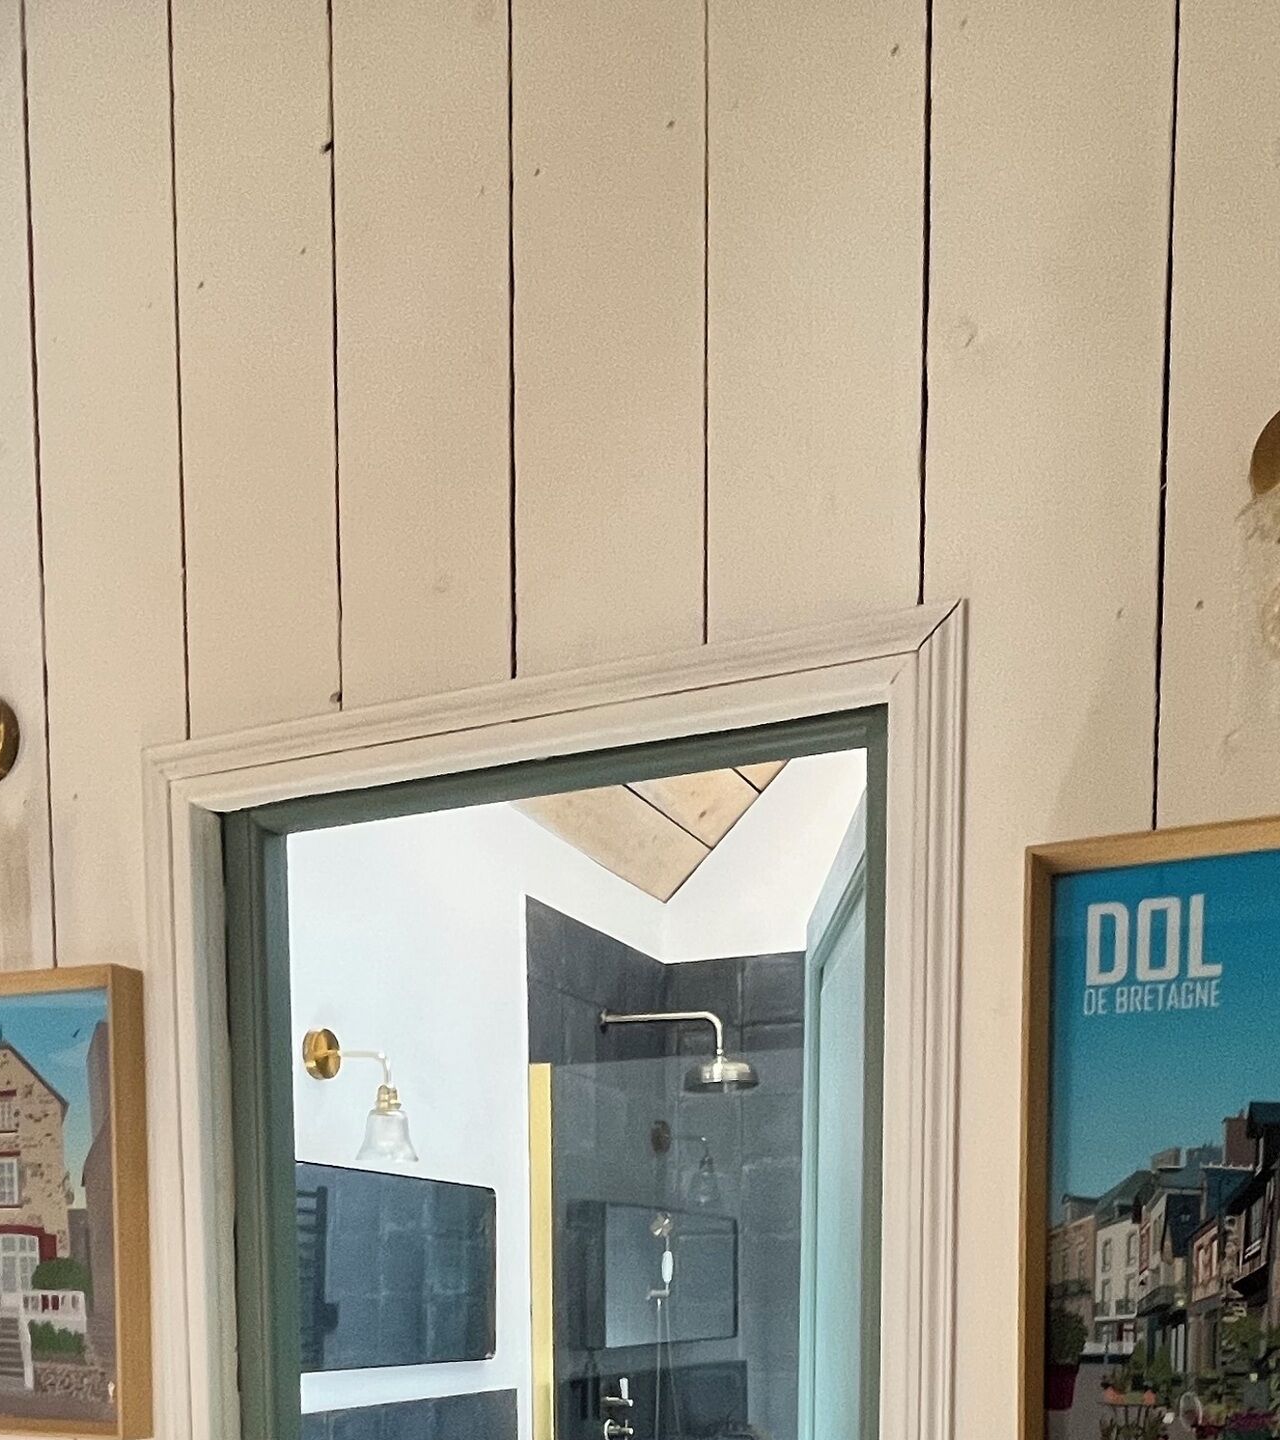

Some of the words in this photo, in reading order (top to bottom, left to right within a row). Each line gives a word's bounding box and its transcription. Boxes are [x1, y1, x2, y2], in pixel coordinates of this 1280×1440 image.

[1085, 893, 1223, 986] DOL
[1083, 988, 1108, 1015] DE
[1115, 979, 1221, 1014] BRETAGNE
